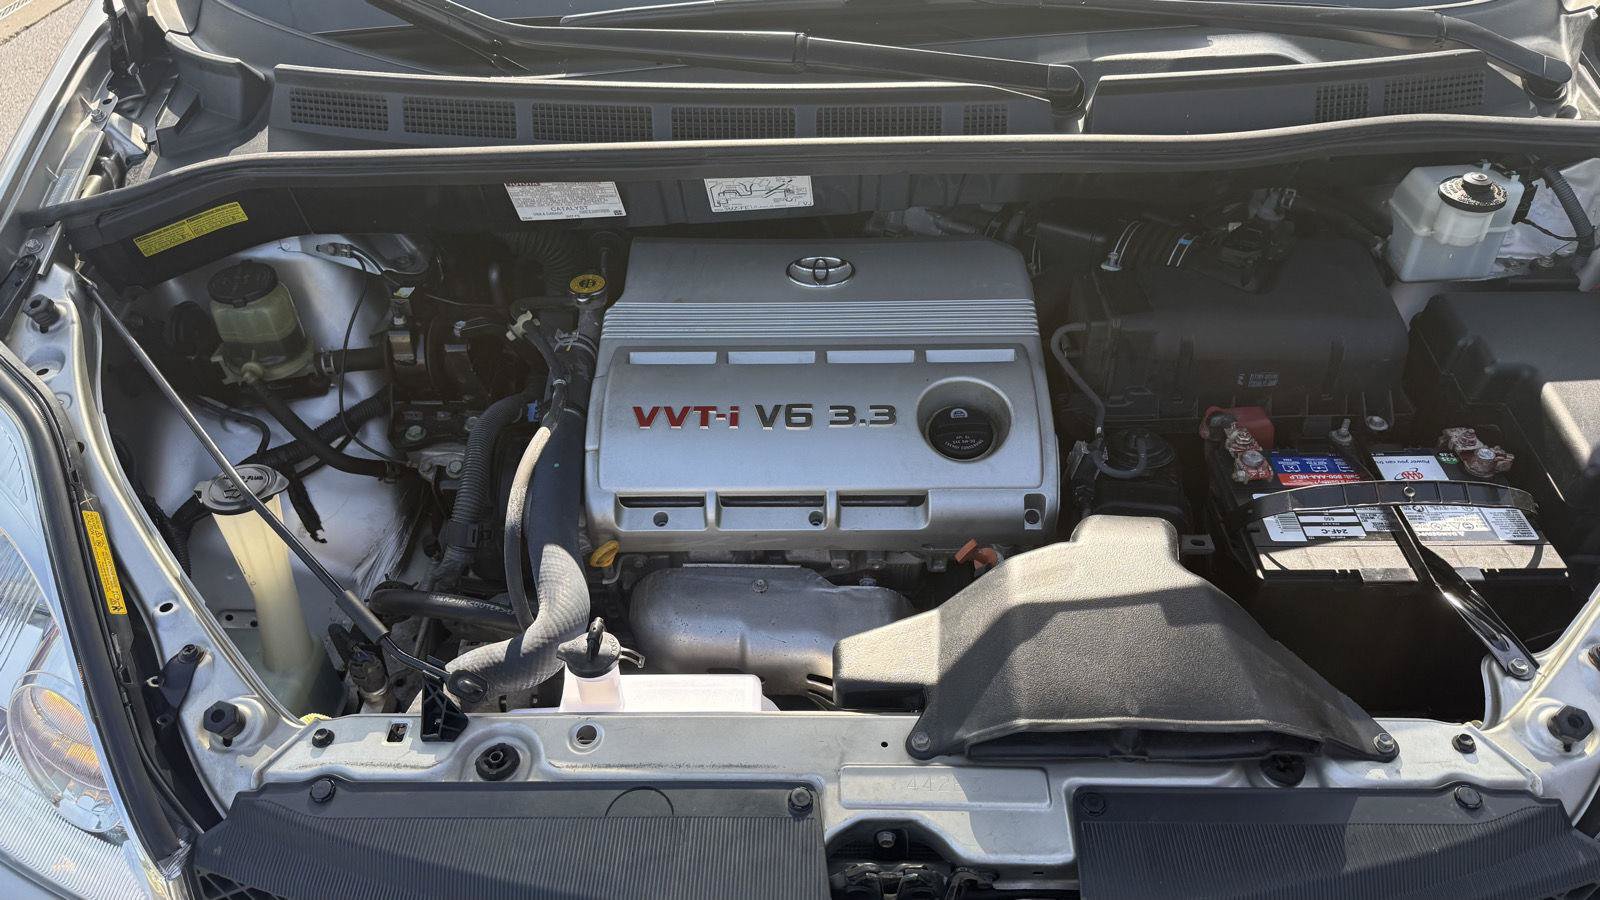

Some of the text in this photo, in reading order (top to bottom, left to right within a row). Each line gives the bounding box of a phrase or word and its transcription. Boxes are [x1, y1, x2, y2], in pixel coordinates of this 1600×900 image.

[633, 403, 897, 431] VVT-i V6 3.3
[1400, 470, 1424, 481] AAA
